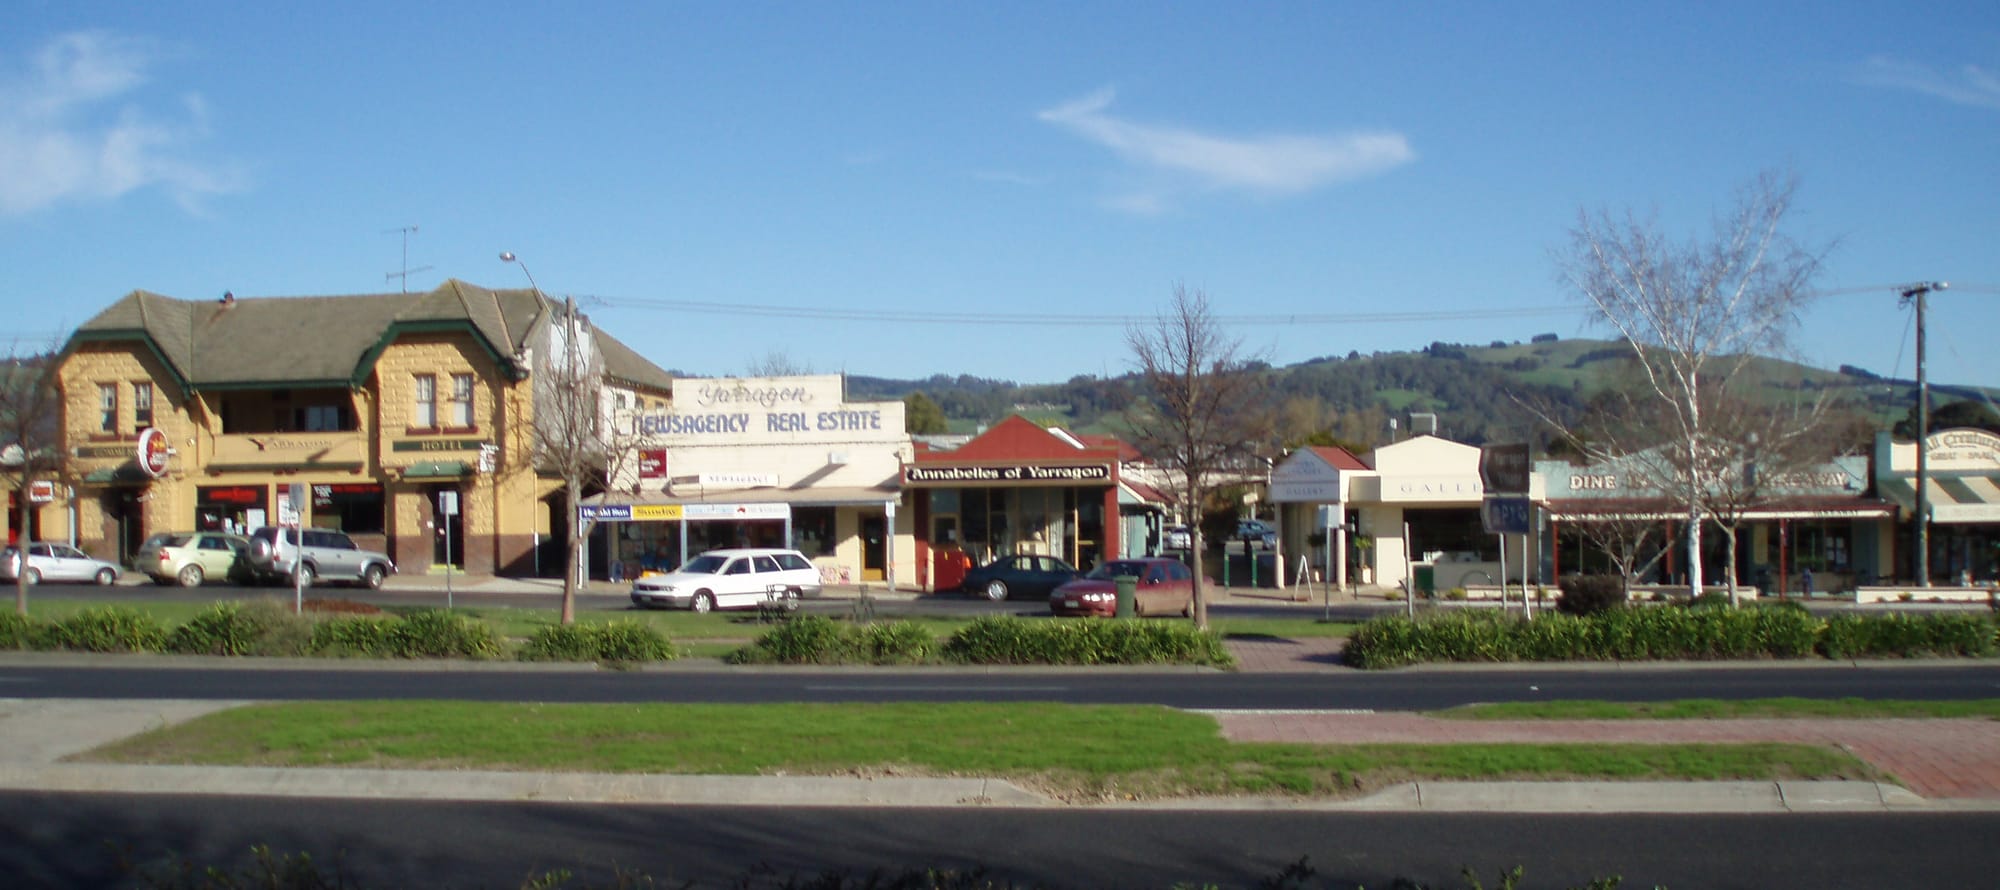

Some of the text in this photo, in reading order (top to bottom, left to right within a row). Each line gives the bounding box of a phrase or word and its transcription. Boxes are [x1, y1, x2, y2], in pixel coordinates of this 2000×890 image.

[697, 384, 815, 408] Yarragon
[632, 410, 881, 435] NEWSAGENCY REAL ESTATE
[421, 440, 463, 451] HOTEL
[911, 466, 1105, 480] Annabelles of Yarragon
[1400, 483, 1480, 493] GALLE
[1569, 474, 1617, 490] DINE
